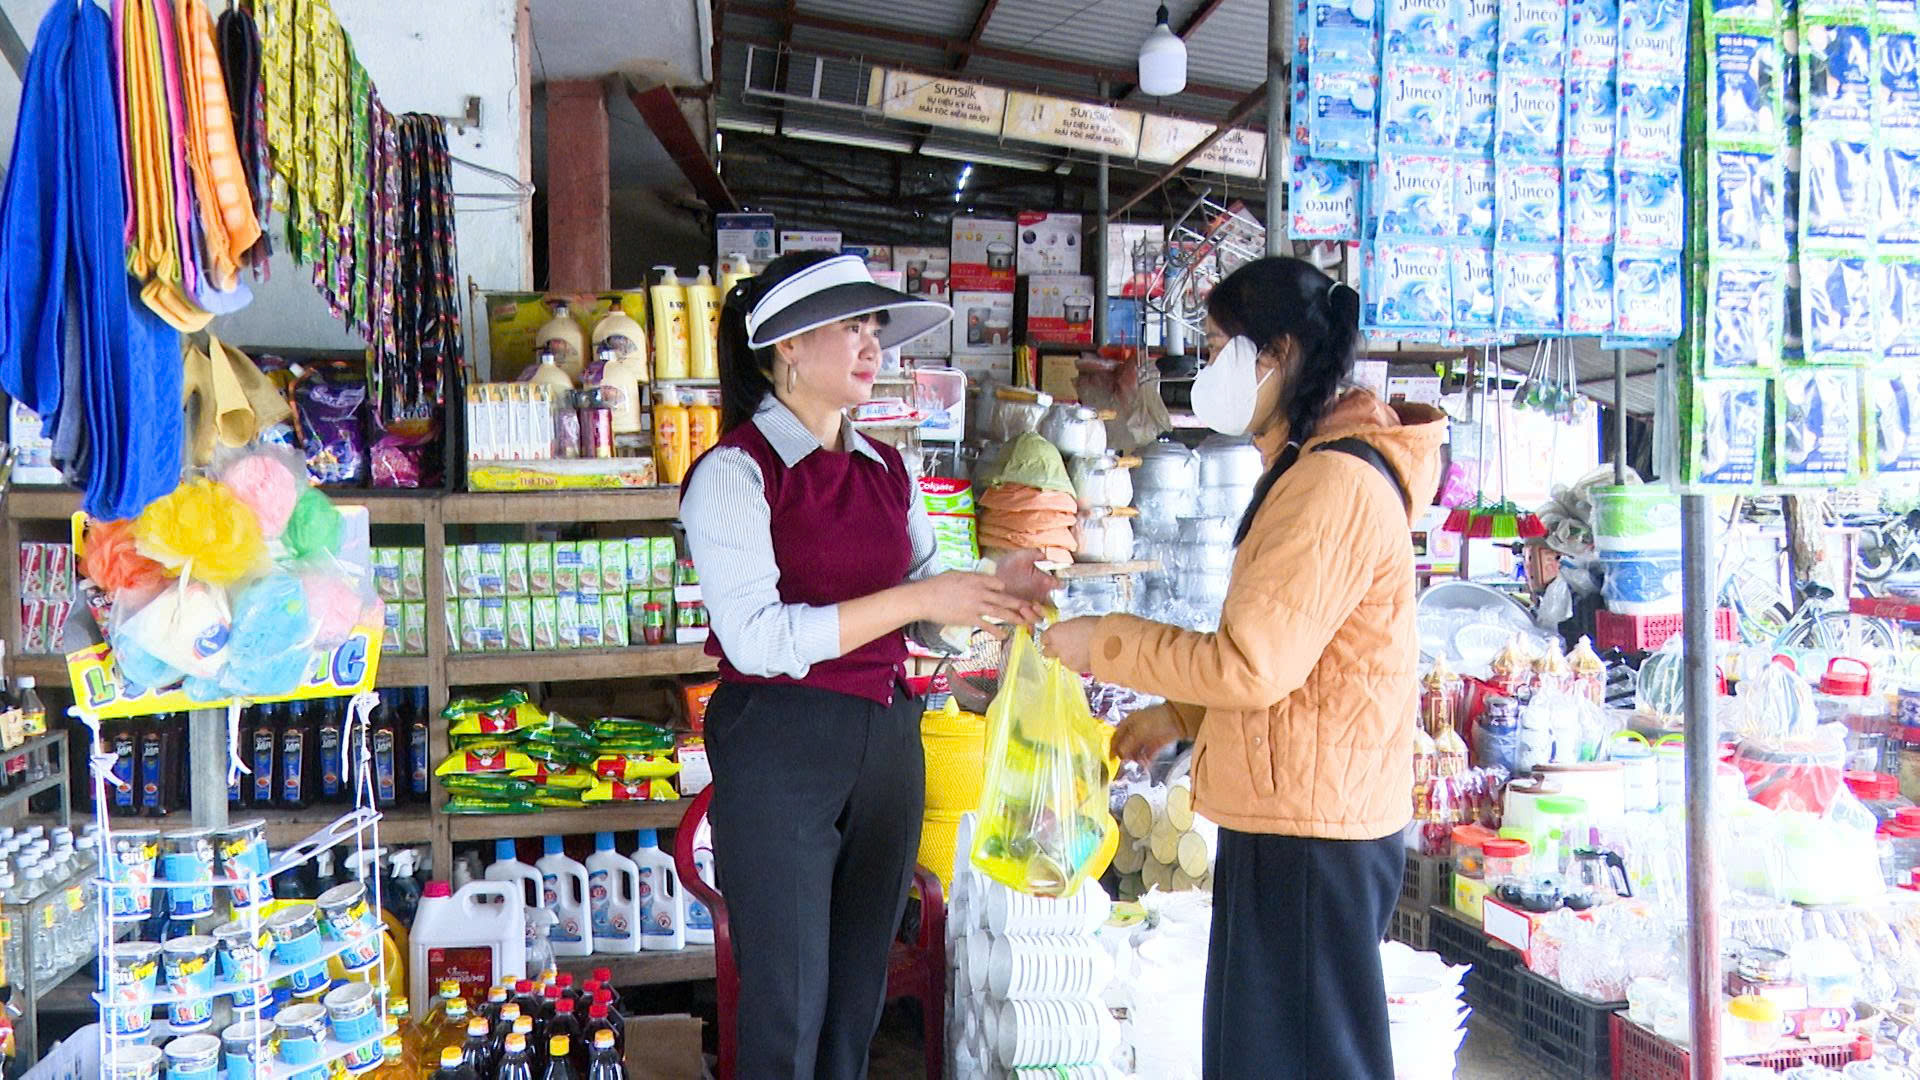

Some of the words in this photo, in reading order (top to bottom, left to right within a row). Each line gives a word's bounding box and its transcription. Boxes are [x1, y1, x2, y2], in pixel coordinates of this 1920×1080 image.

[1467, 0, 1498, 17] Jun
[1514, 1, 1558, 23] Junco
[1396, 79, 1442, 101] Junco
[1466, 87, 1496, 107] Junc
[1510, 91, 1555, 113] Junco
[1393, 170, 1440, 191] Junco
[1465, 174, 1495, 195] Junc
[1510, 179, 1554, 200] Junco
[1306, 196, 1353, 219] Junco
[1391, 257, 1438, 279] Junco
[1464, 260, 1494, 282] Jun
[920, 481, 955, 492] Colgate
